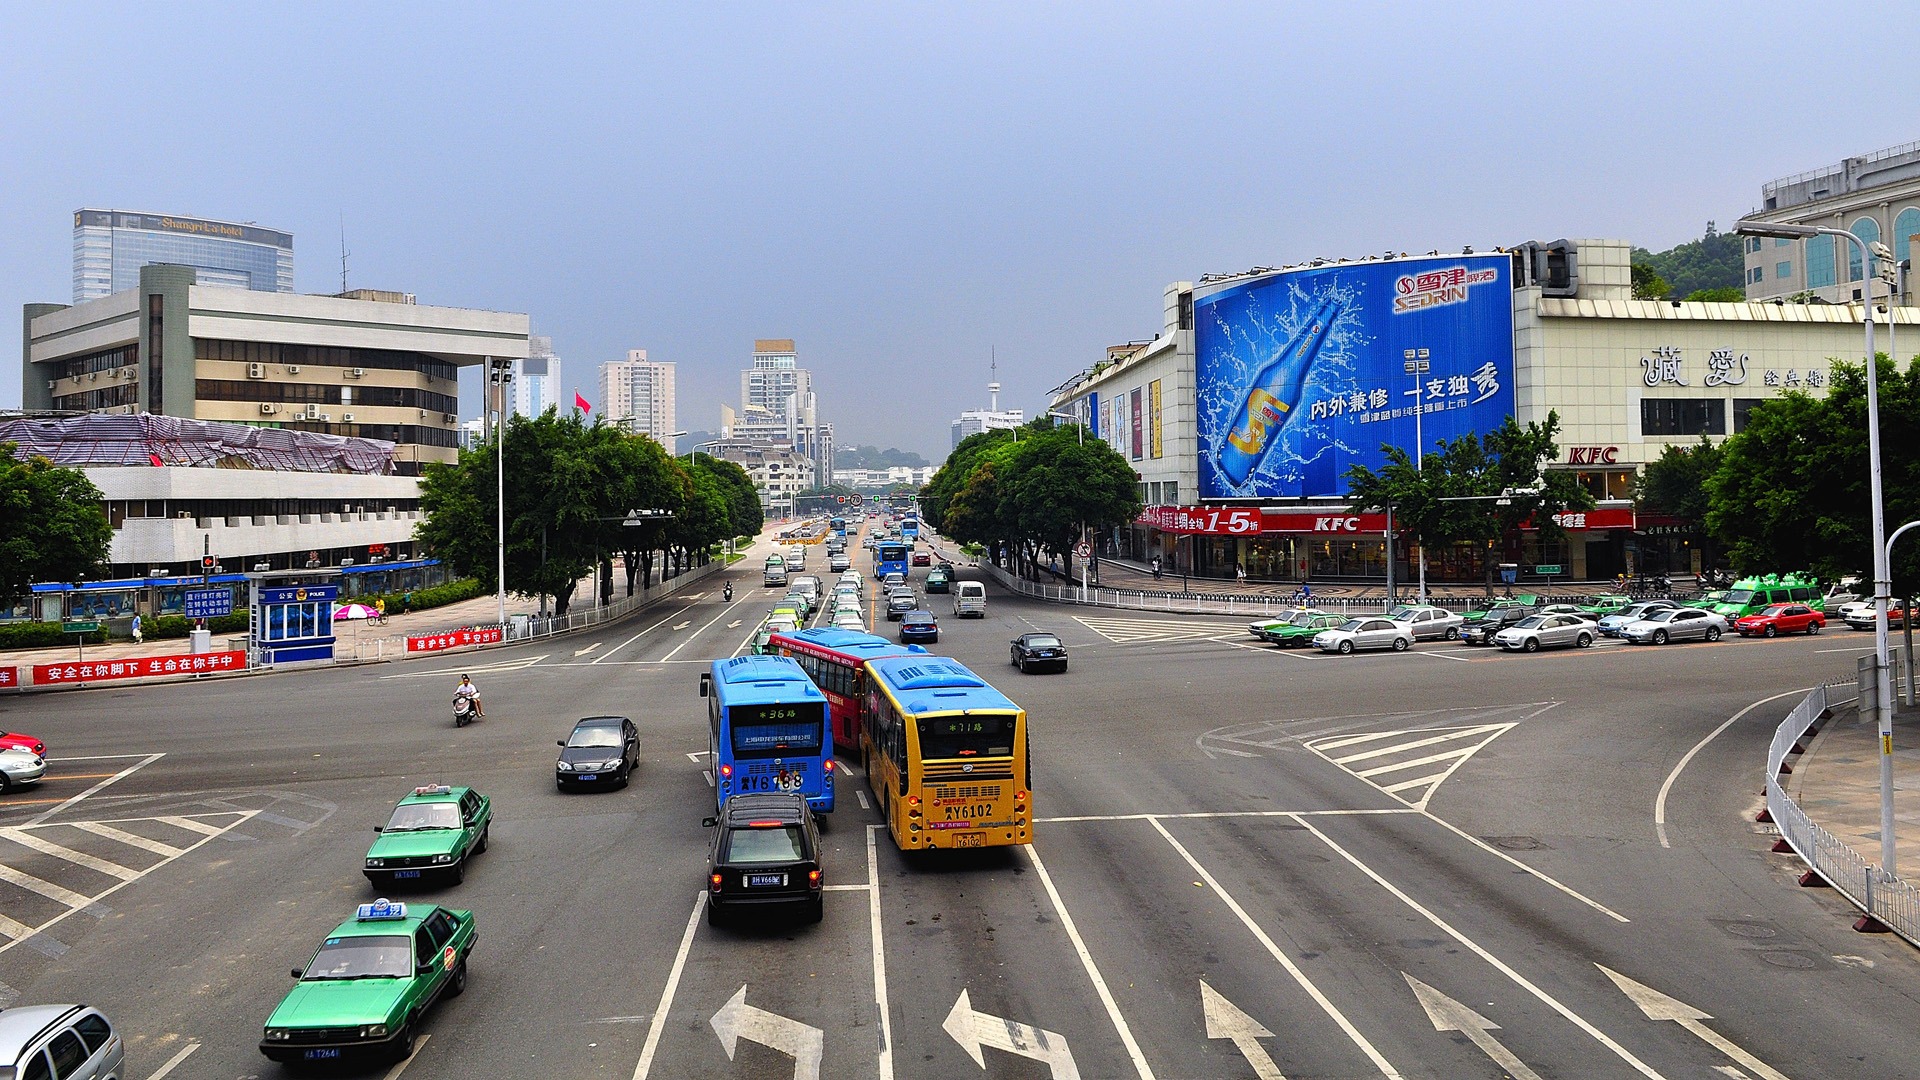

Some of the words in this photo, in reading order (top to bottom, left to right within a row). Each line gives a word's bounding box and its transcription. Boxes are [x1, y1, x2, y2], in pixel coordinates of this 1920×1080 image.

[1417, 268, 1466, 293] 雪津
[1395, 286, 1466, 313] SEDRIN
[1310, 388, 1388, 421] 内外兼修
[1568, 446, 1619, 465] KFC
[1314, 517, 1360, 531] KFC
[278, 592, 293, 600] 公安
[417, 636, 456, 649] 保护生命
[463, 632, 498, 643] 平安出行
[48, 662, 139, 680] 安全在你脚下
[150, 655, 233, 673] 生命在你手中
